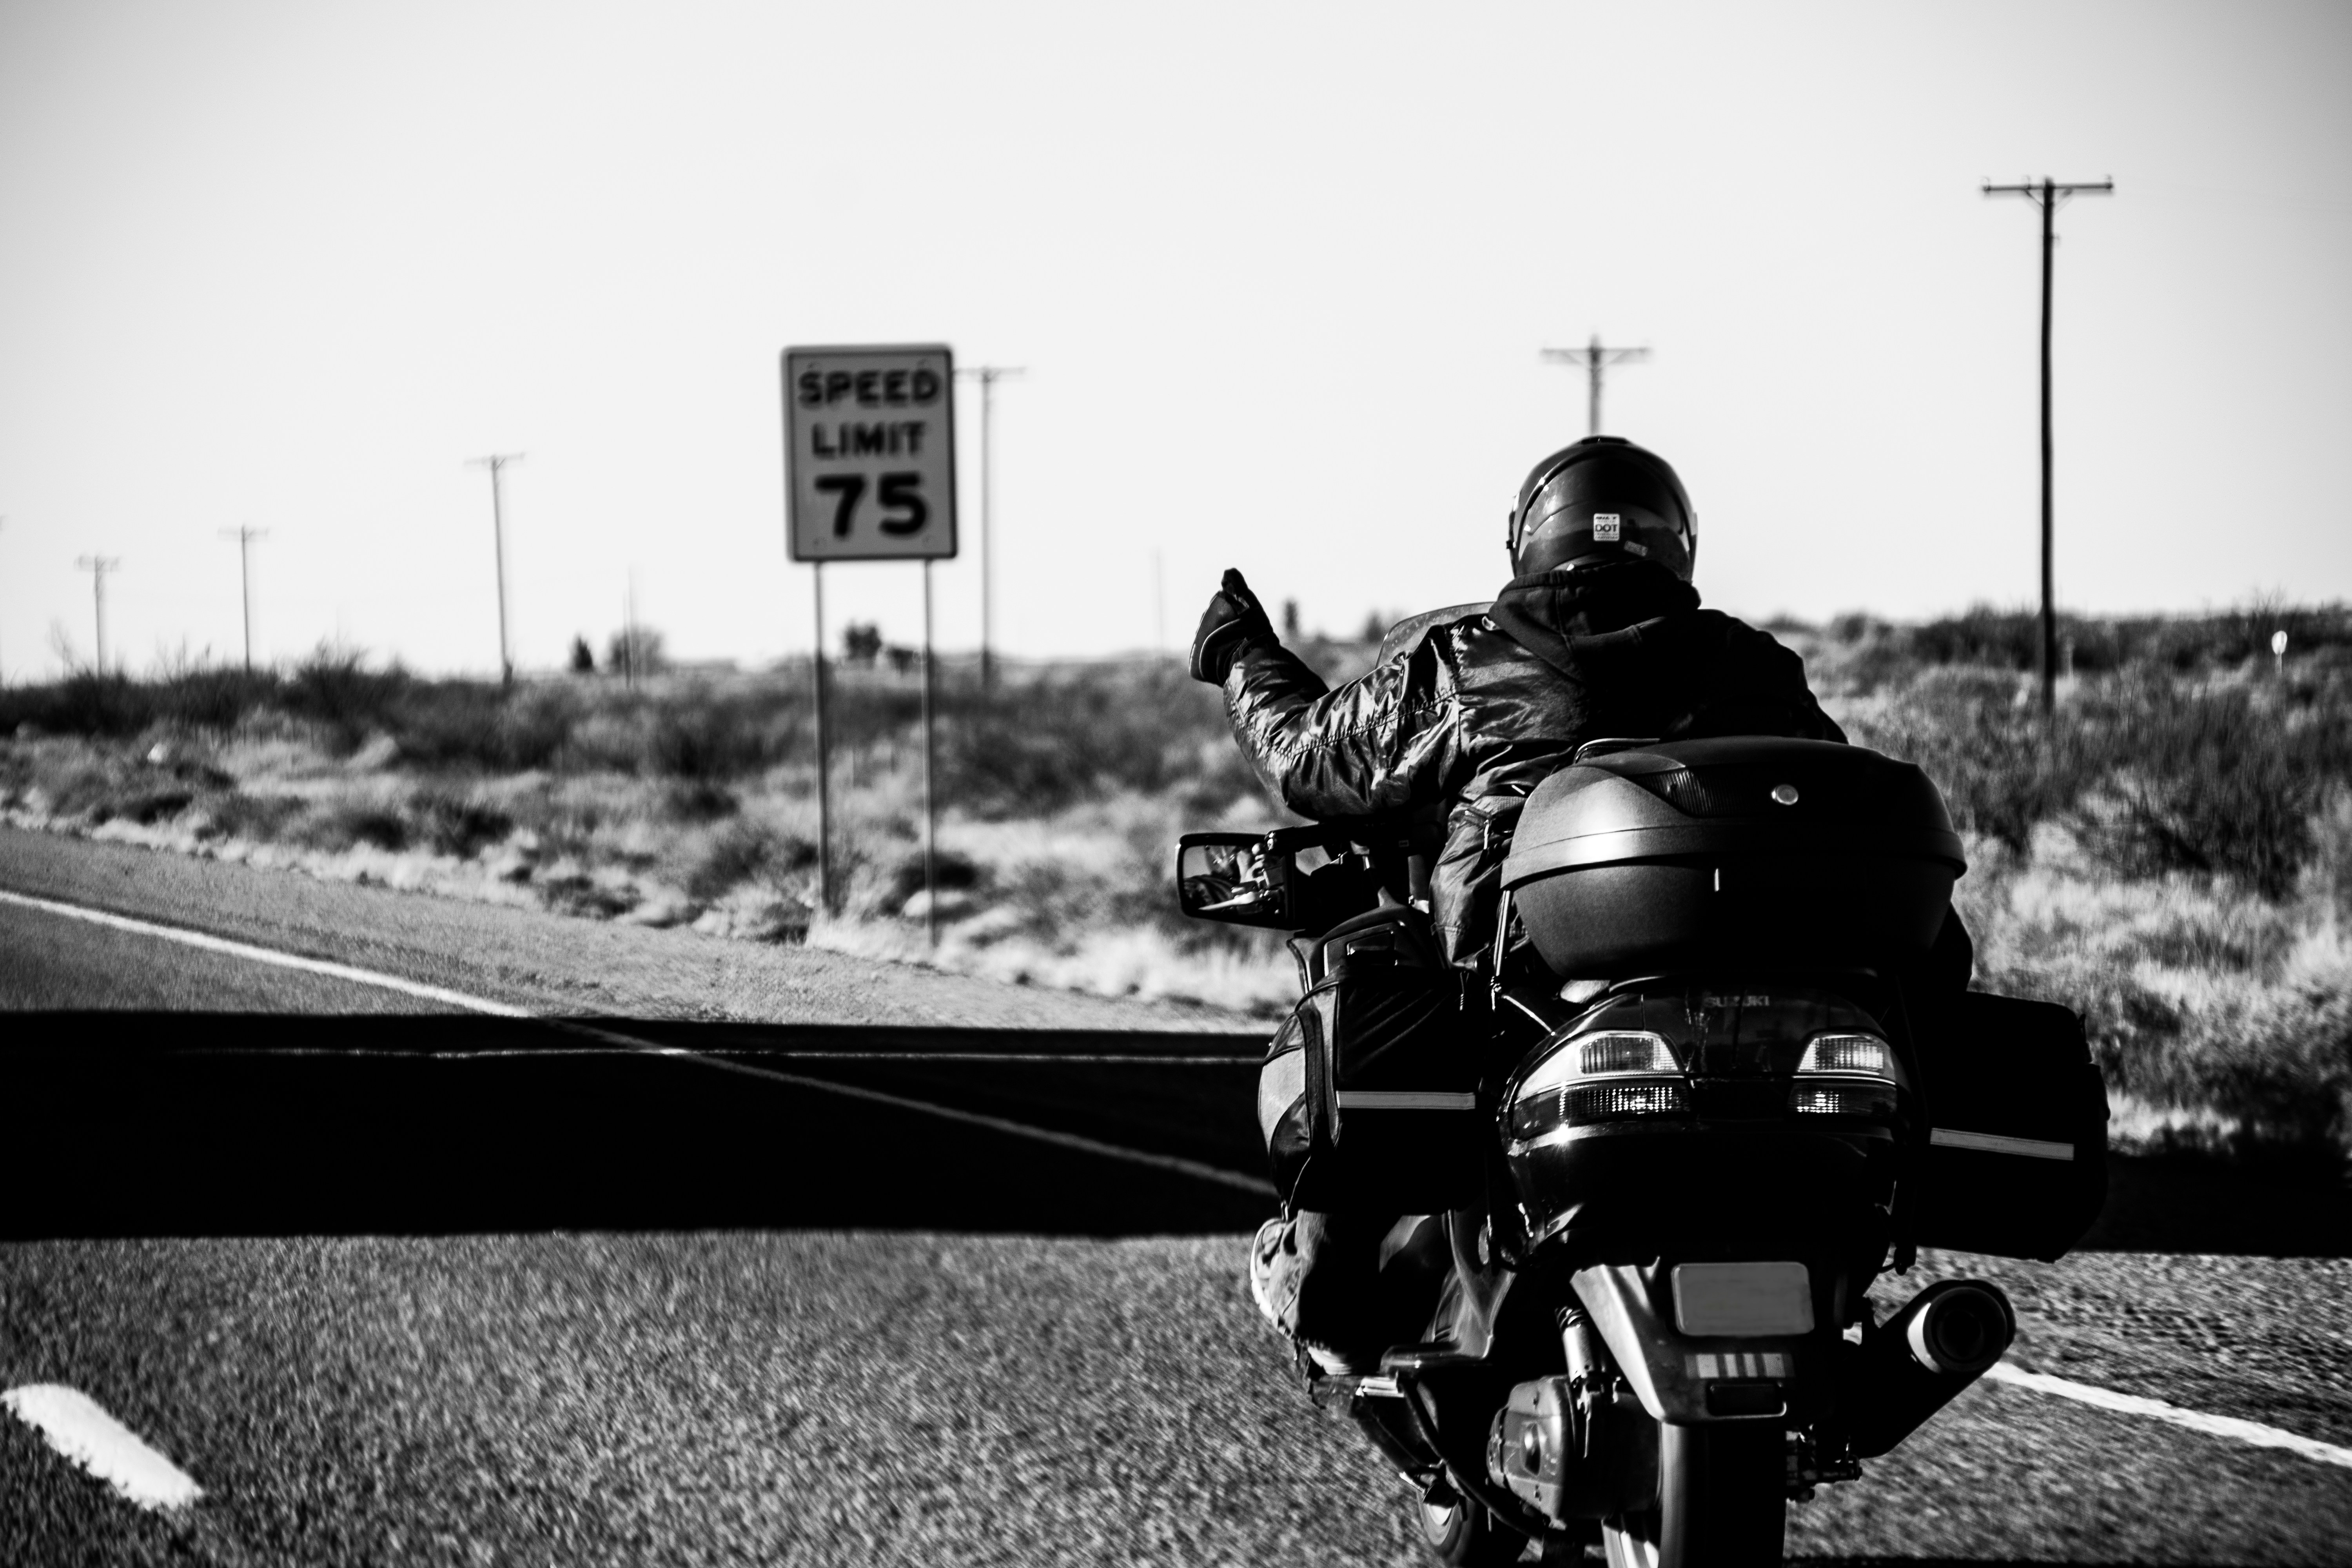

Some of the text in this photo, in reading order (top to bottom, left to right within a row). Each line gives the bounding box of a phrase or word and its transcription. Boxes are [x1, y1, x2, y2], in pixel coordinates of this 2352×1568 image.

[799, 369, 940, 406] SPEED
[811, 421, 926, 457] LIMIT
[815, 473, 928, 538] 75
[1595, 524, 1617, 532] DOT
[1703, 995, 1769, 1007] SUZUKI
